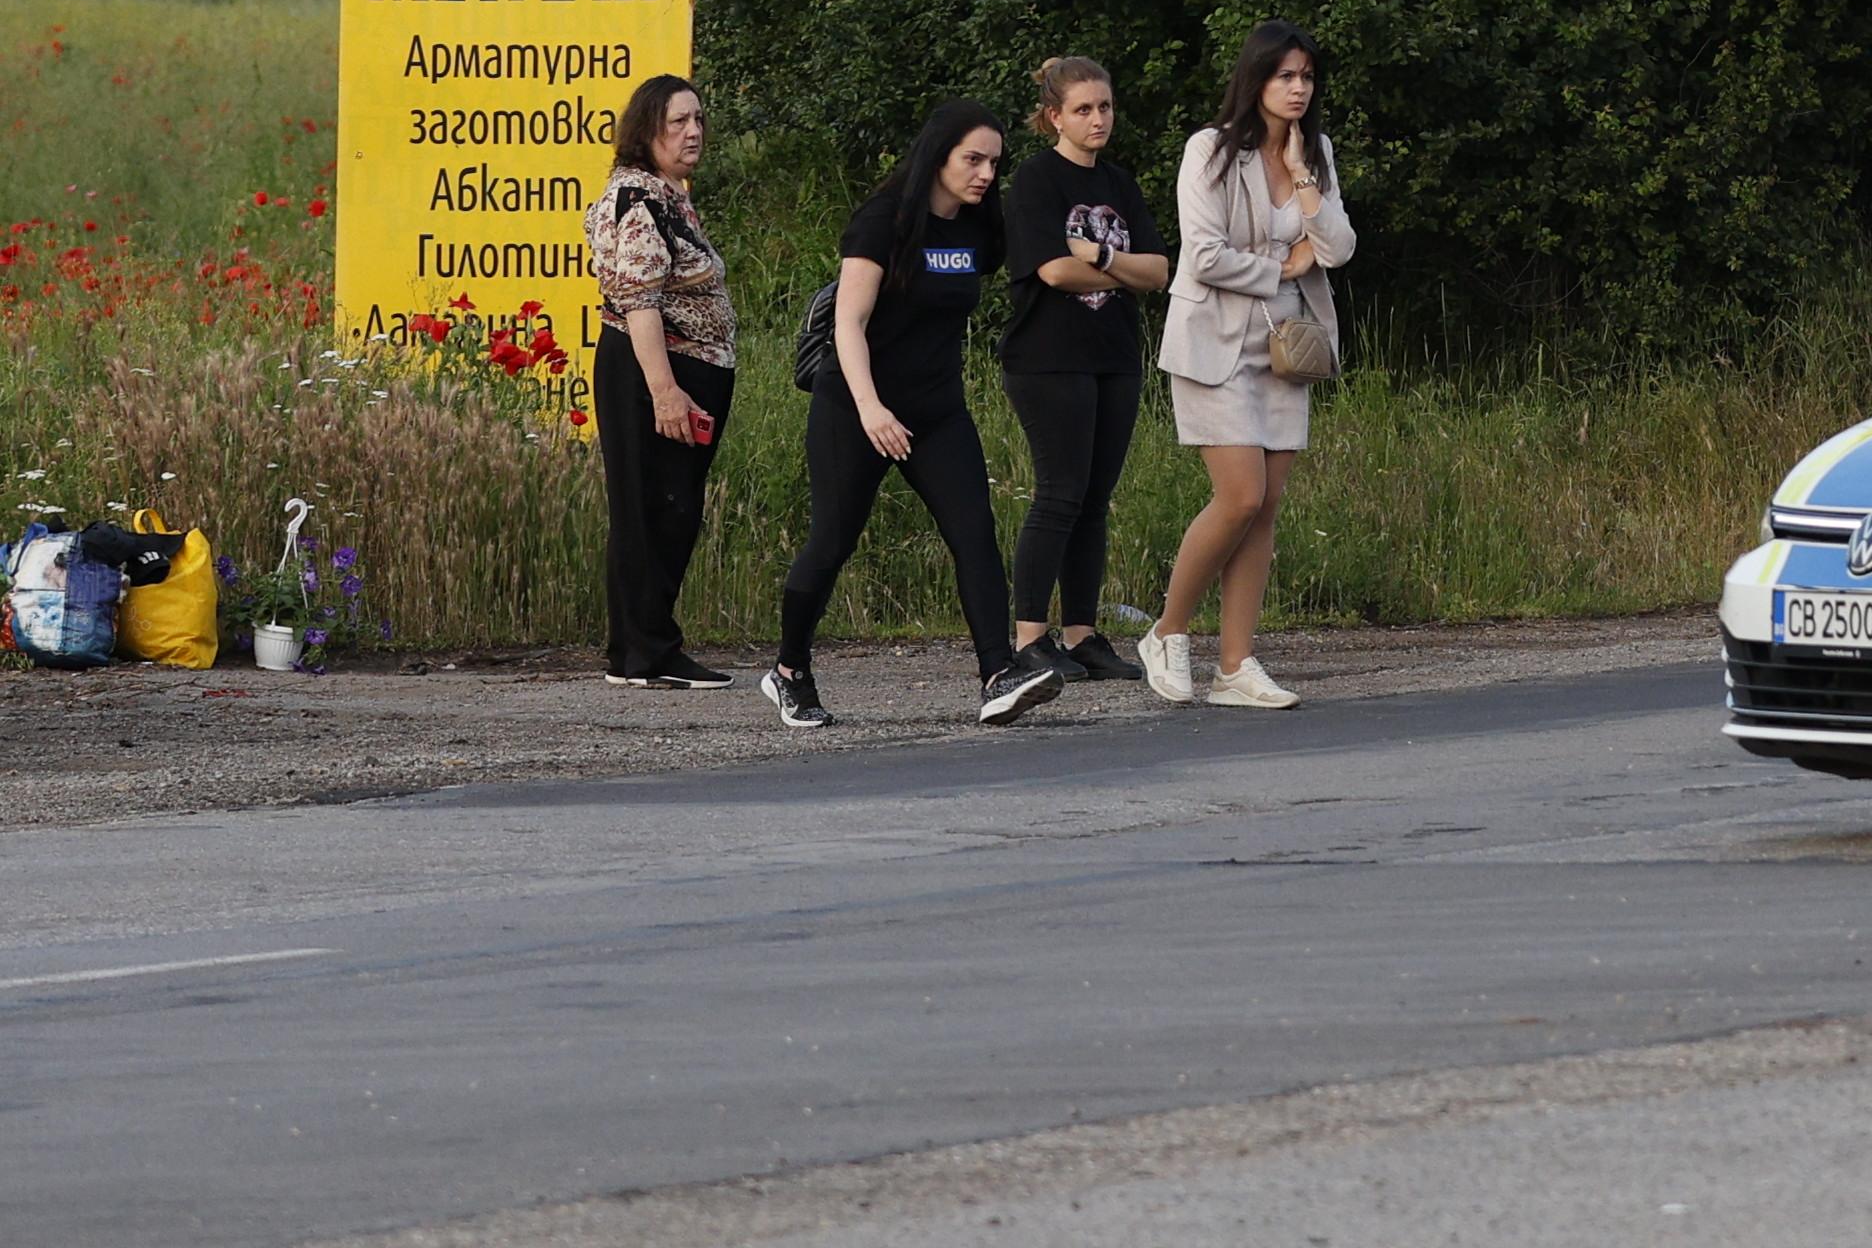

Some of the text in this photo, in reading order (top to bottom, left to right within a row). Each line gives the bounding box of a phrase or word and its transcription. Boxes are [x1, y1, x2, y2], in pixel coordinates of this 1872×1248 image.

[403, 34, 632, 85] Арматурна
[409, 95, 617, 145] заготовка
[926, 252, 971, 270] HUGO
[1788, 598, 1817, 638] CB
